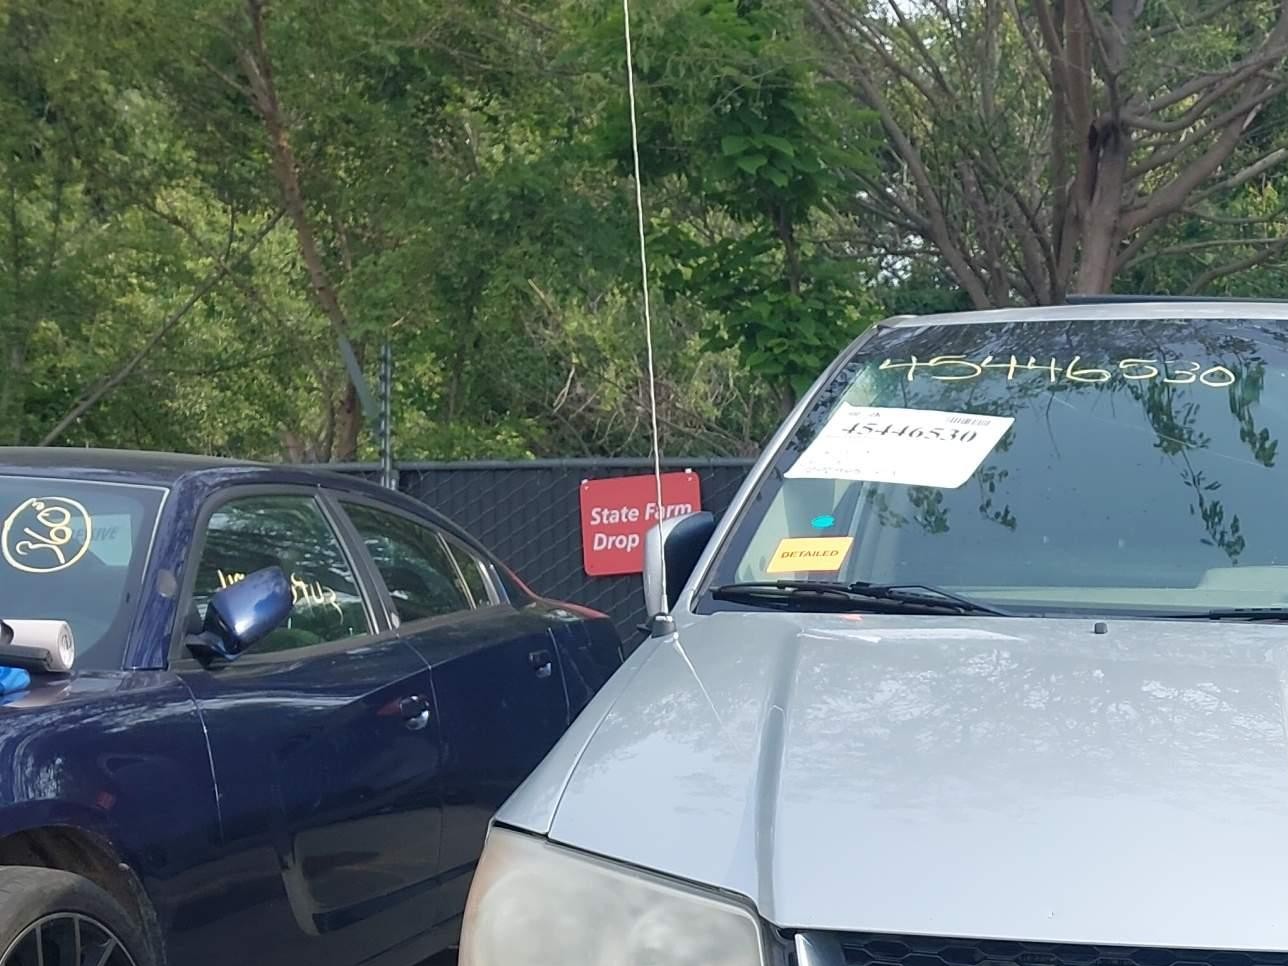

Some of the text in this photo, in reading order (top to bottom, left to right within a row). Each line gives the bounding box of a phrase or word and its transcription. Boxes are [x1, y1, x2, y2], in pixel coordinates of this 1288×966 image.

[879, 354, 1236, 387] 45446530
[841, 422, 978, 443] 45446530
[590, 502, 693, 526] State Farm
[593, 532, 640, 553] Drop
[780, 550, 840, 559] DETAILED
